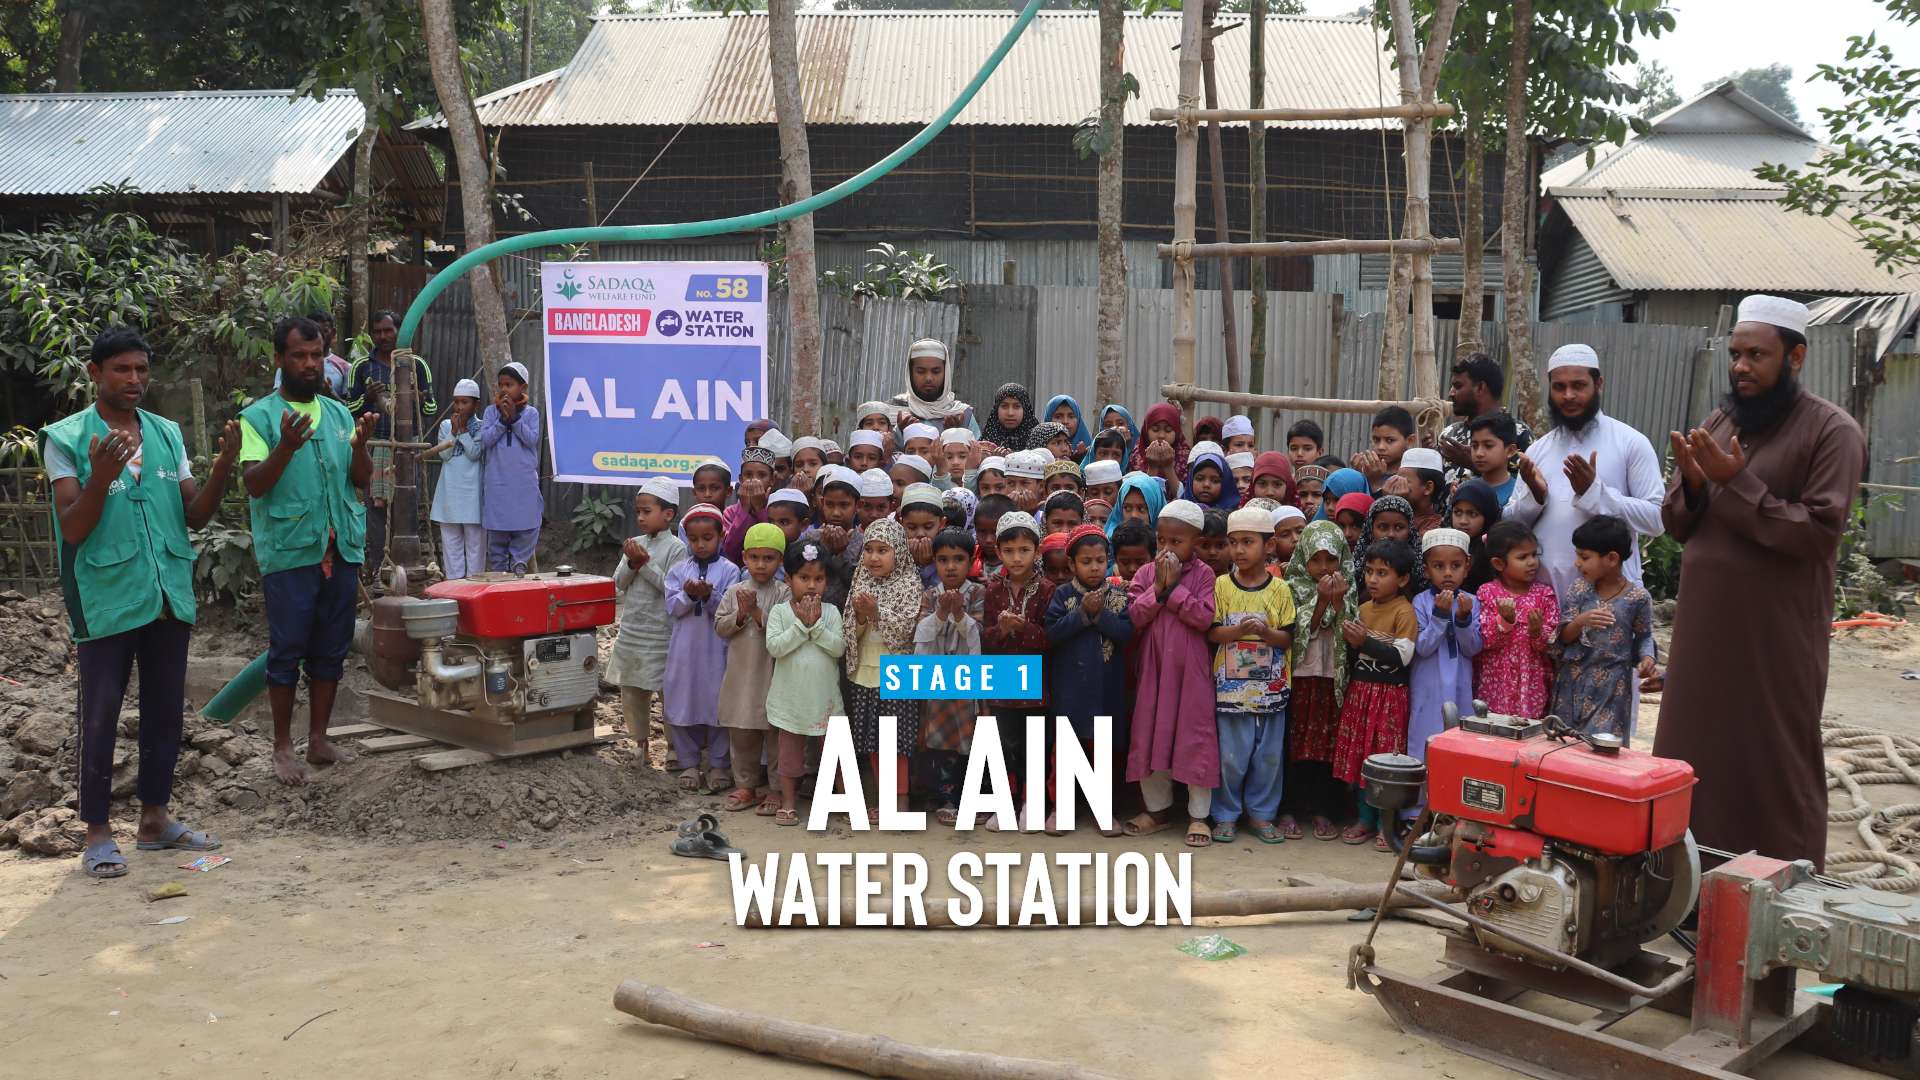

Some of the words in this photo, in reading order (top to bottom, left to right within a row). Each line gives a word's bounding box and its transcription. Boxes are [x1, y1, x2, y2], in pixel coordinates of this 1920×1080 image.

[588, 275, 655, 293] SADAQA
[696, 290, 713, 298] NO.
[716, 278, 749, 298] 58
[589, 293, 628, 301] WELFARE
[630, 293, 656, 301] FUND
[554, 312, 641, 332] BANGLADESH
[685, 310, 744, 323] WATER
[685, 324, 754, 338] STATION
[560, 377, 636, 419] AL
[651, 379, 753, 422] AIN
